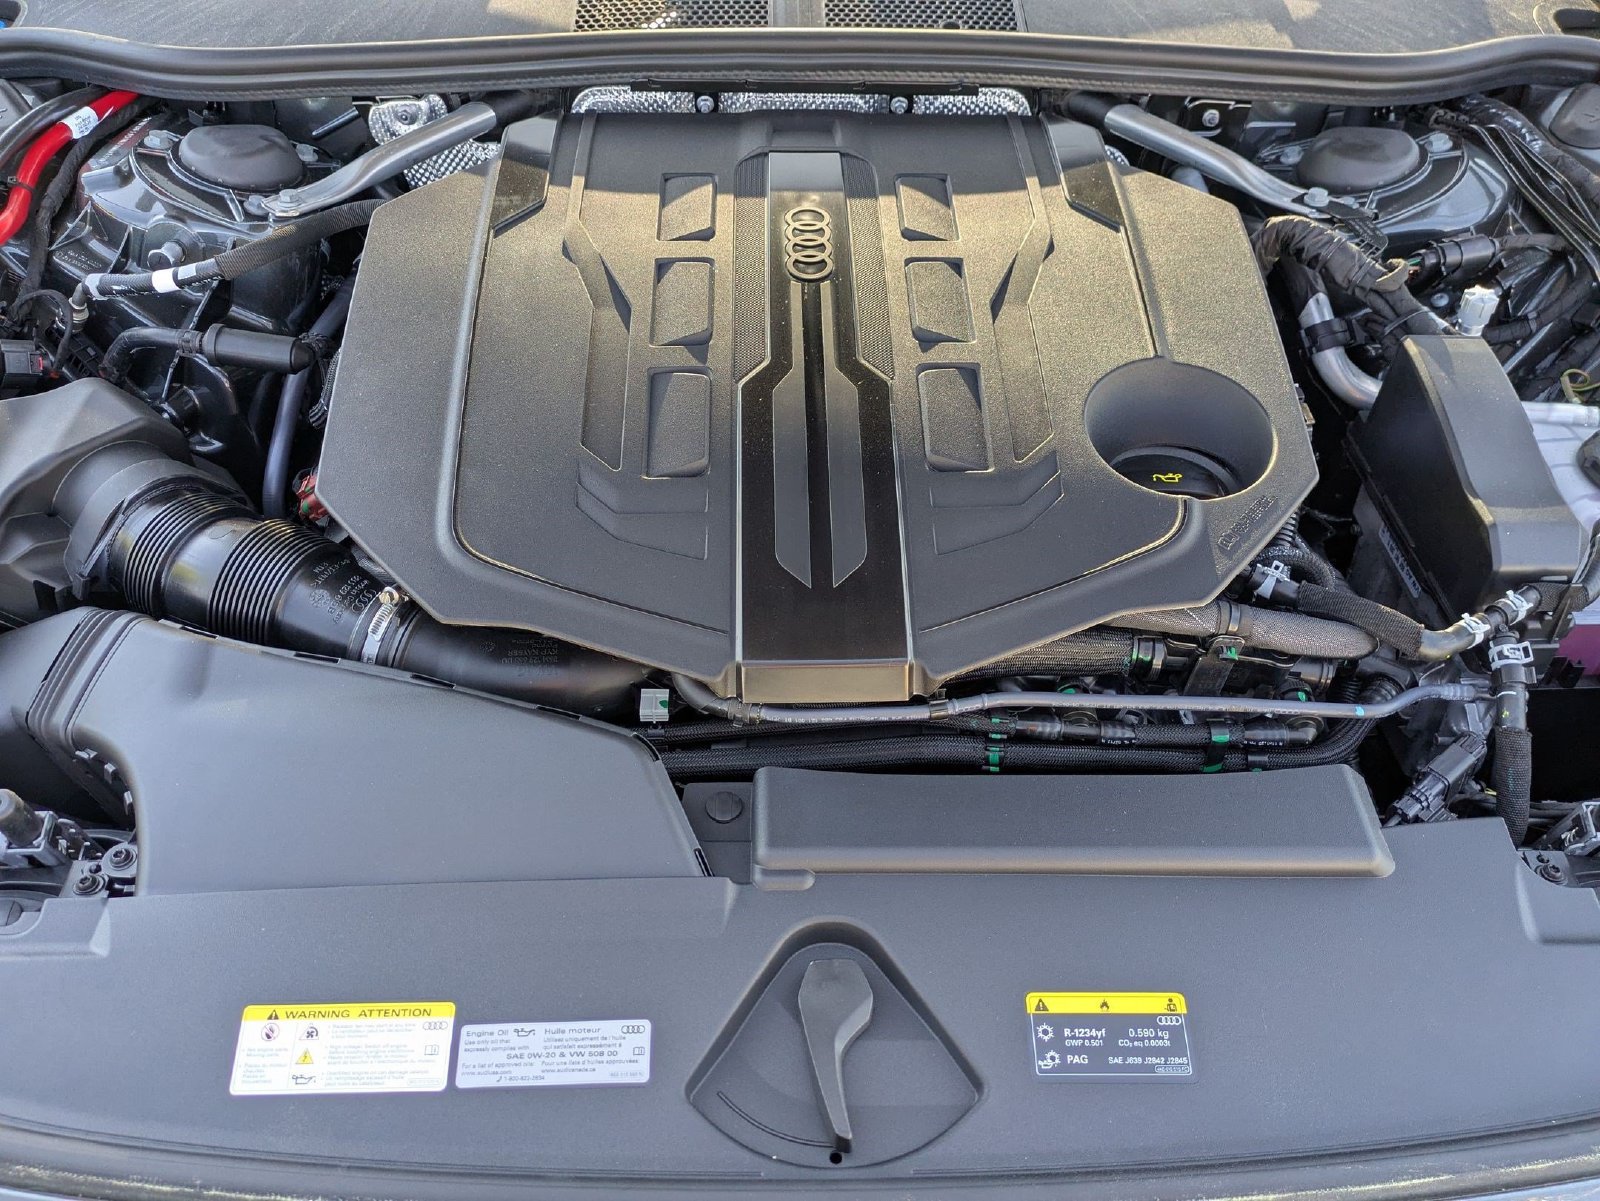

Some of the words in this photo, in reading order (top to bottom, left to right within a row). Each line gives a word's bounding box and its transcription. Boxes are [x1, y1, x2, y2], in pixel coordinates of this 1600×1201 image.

[286, 1010, 350, 1019] WARNING
[358, 1008, 432, 1018] ATTENTION
[1064, 1028, 1106, 1038] R-1234yf
[1128, 1028, 1155, 1037] 0.590
[1158, 1029, 1169, 1039] kg
[1066, 1055, 1088, 1064] PAG
